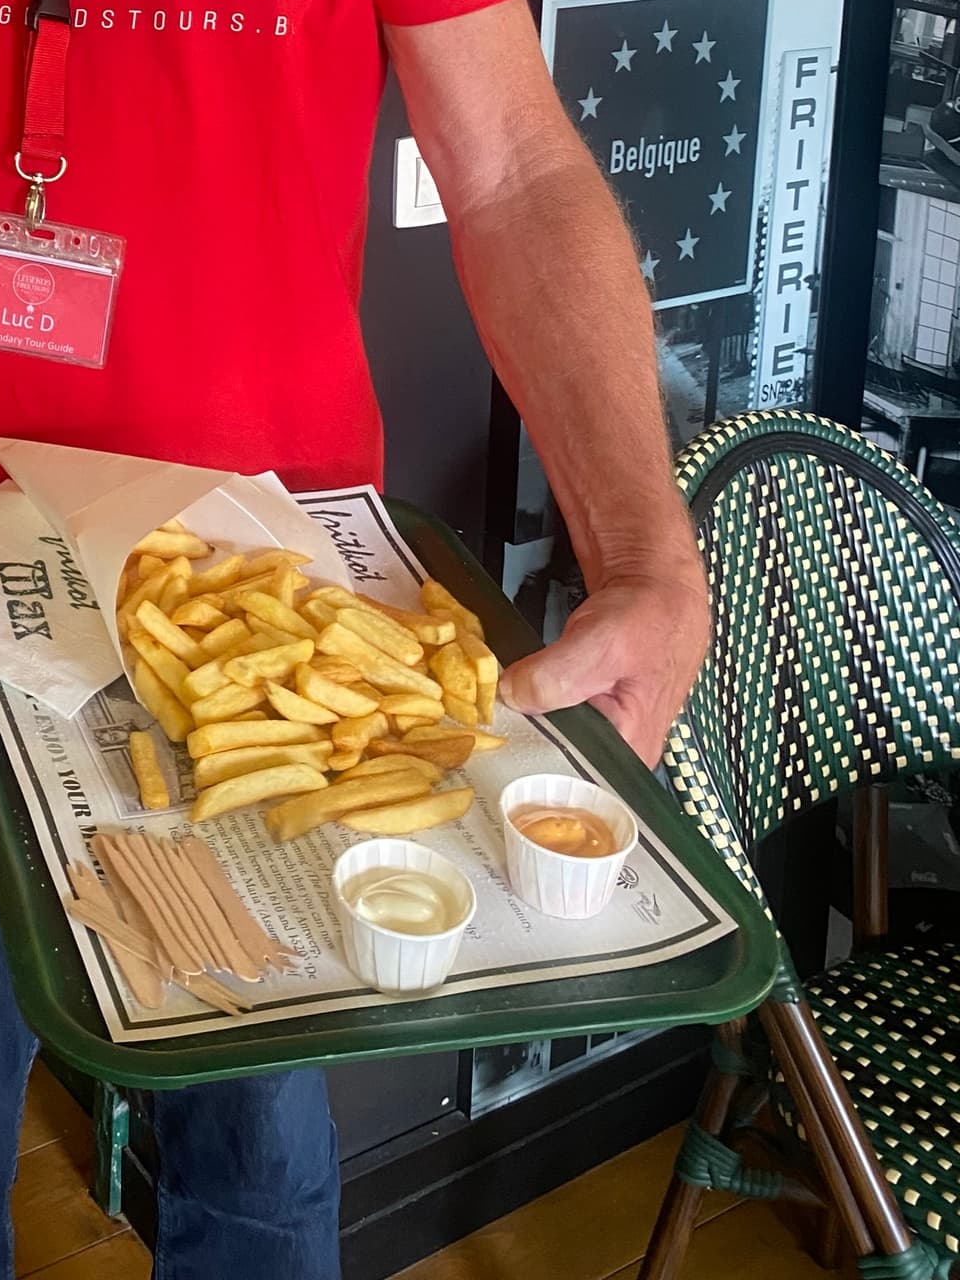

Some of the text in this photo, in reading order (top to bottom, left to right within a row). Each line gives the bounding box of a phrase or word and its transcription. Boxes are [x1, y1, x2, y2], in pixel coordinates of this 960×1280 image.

[609, 134, 702, 178] Belgique
[770, 55, 820, 377] FRITERIE
[1, 307, 55, 332] Luc D
[25, 336, 46, 348] Tour
[47, 341, 75, 354] Guide
[57, 768, 92, 818] YOUR
[268, 863, 297, 903] cathedral
[298, 893, 315, 910] you
[277, 913, 295, 931] and
